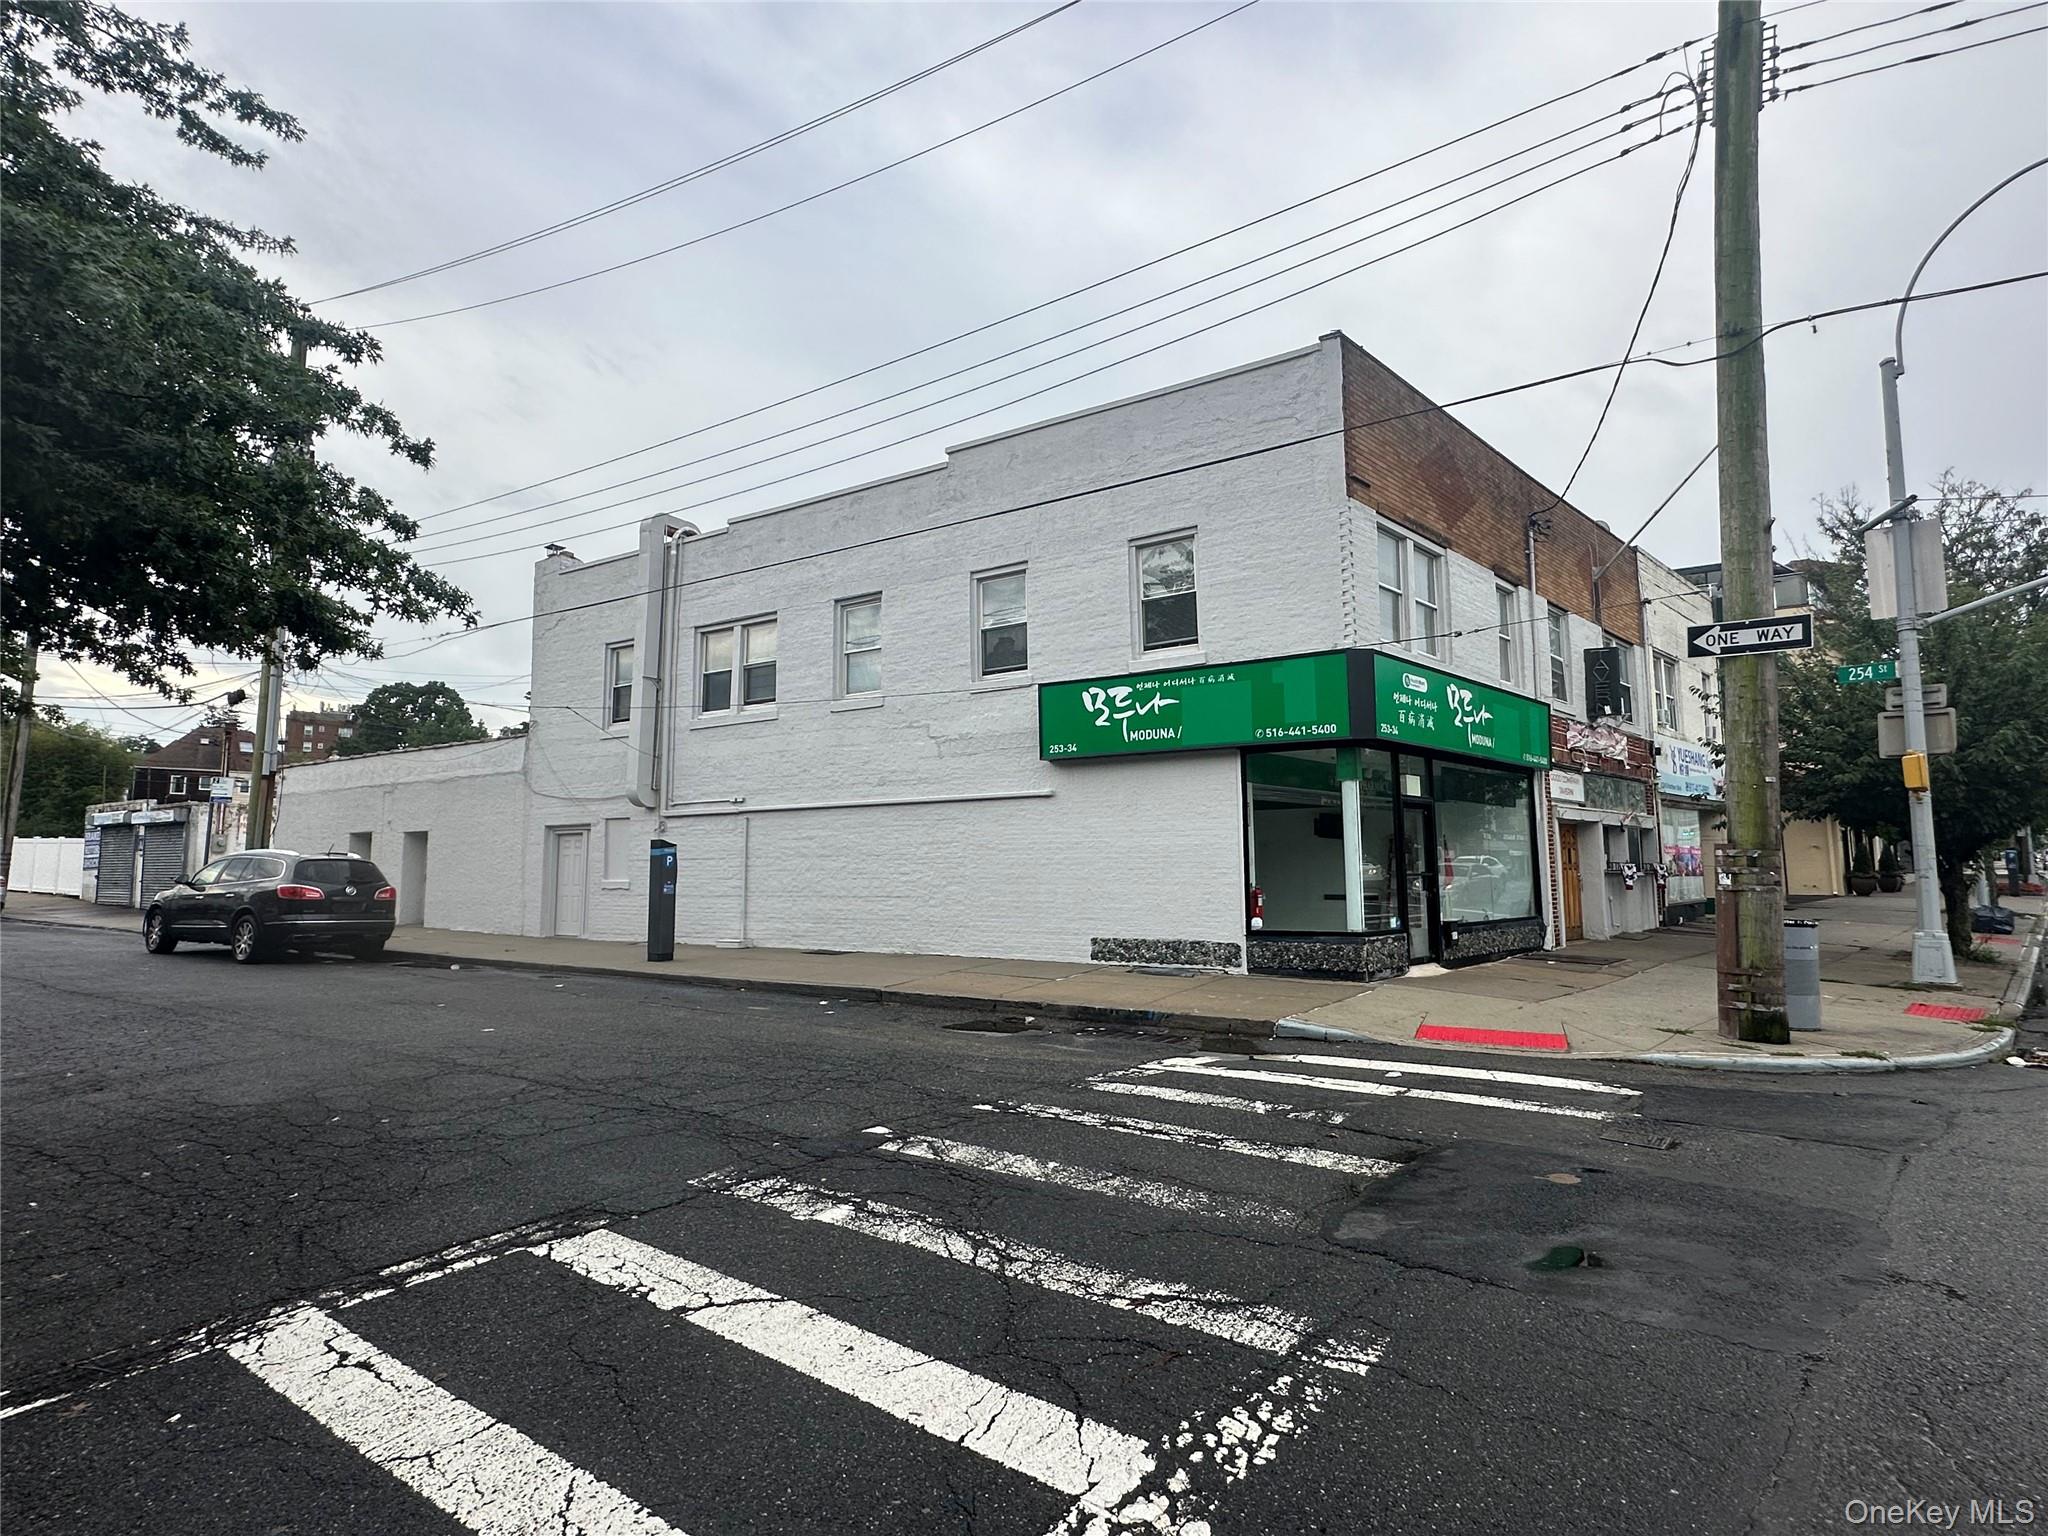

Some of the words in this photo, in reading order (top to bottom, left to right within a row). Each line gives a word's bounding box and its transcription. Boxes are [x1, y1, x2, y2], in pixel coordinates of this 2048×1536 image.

[1706, 632, 1740, 647] ONE
[1757, 626, 1795, 642] WAY
[1849, 667, 1873, 681] 254
[1163, 676, 1196, 687] 어디서나
[1414, 698, 1438, 712] 어디서나
[1265, 723, 1337, 738] 516-441-5400
[1380, 723, 1399, 735] 253-34
[1049, 743, 1077, 754] 253-34
[666, 856, 673, 866] P
